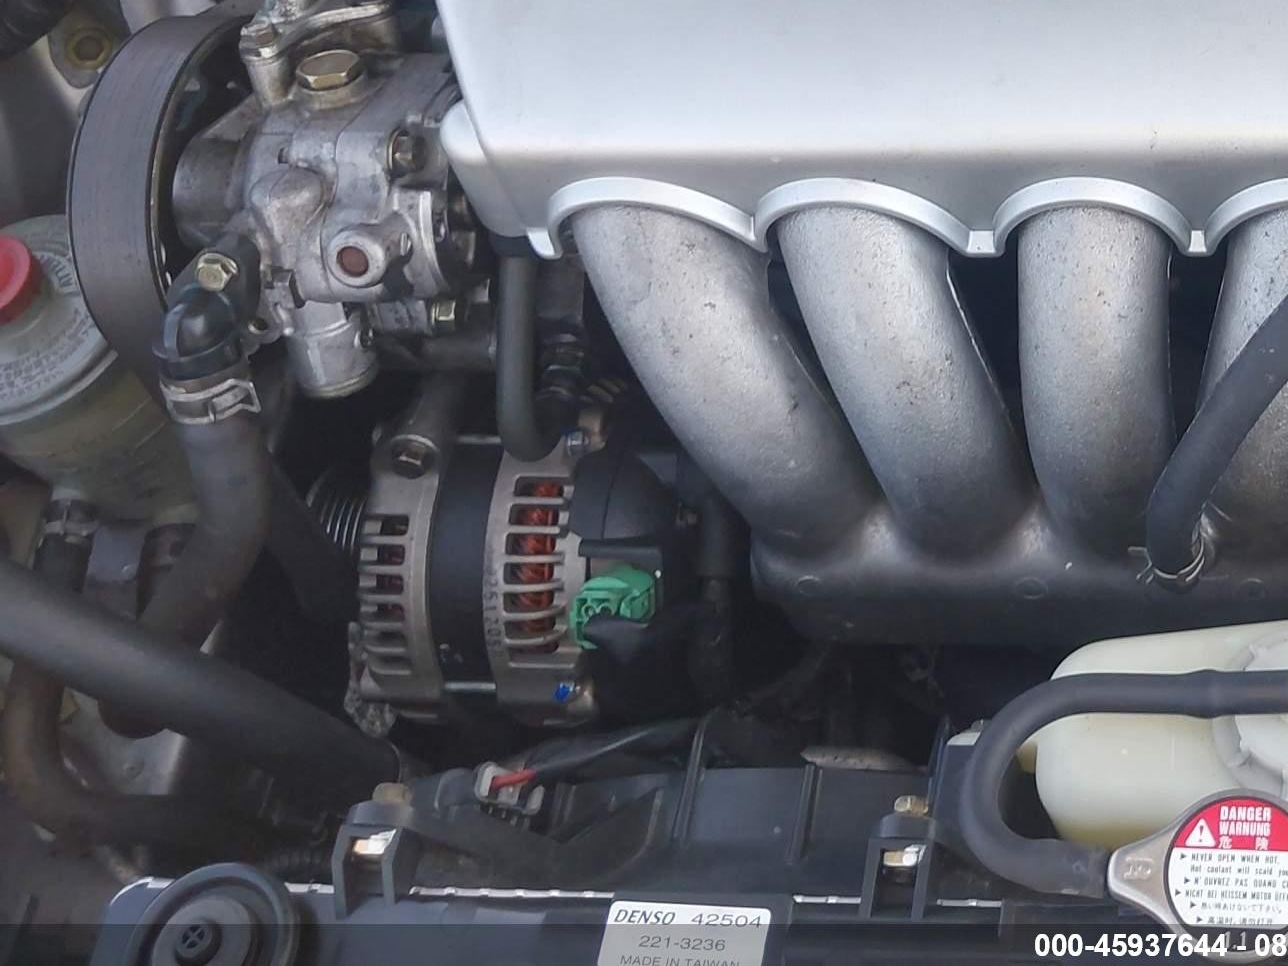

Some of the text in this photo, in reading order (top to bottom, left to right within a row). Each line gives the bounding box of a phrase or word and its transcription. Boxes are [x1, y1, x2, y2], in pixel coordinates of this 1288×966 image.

[1219, 805, 1272, 822] DANGER
[1219, 821, 1272, 837] WARNUNG
[1191, 852, 1213, 862] NEVER
[1218, 853, 1236, 863] OPEN
[1241, 854, 1260, 864] WHEN
[1190, 865, 1202, 873] Hot
[1207, 865, 1233, 875] coolant
[1237, 866, 1250, 875] will
[1255, 867, 1273, 876] scald
[1235, 879, 1248, 888] PAS
[1185, 889, 1204, 898] NICHT
[1207, 889, 1218, 899] BEI
[1220, 890, 1248, 900] HEISSEM
[1251, 891, 1272, 900] MOTOR
[613, 909, 761, 928] DENSO 42504
[638, 935, 726, 951] 221-3236
[620, 955, 661, 966] MADE
[666, 956, 680, 966] IN
